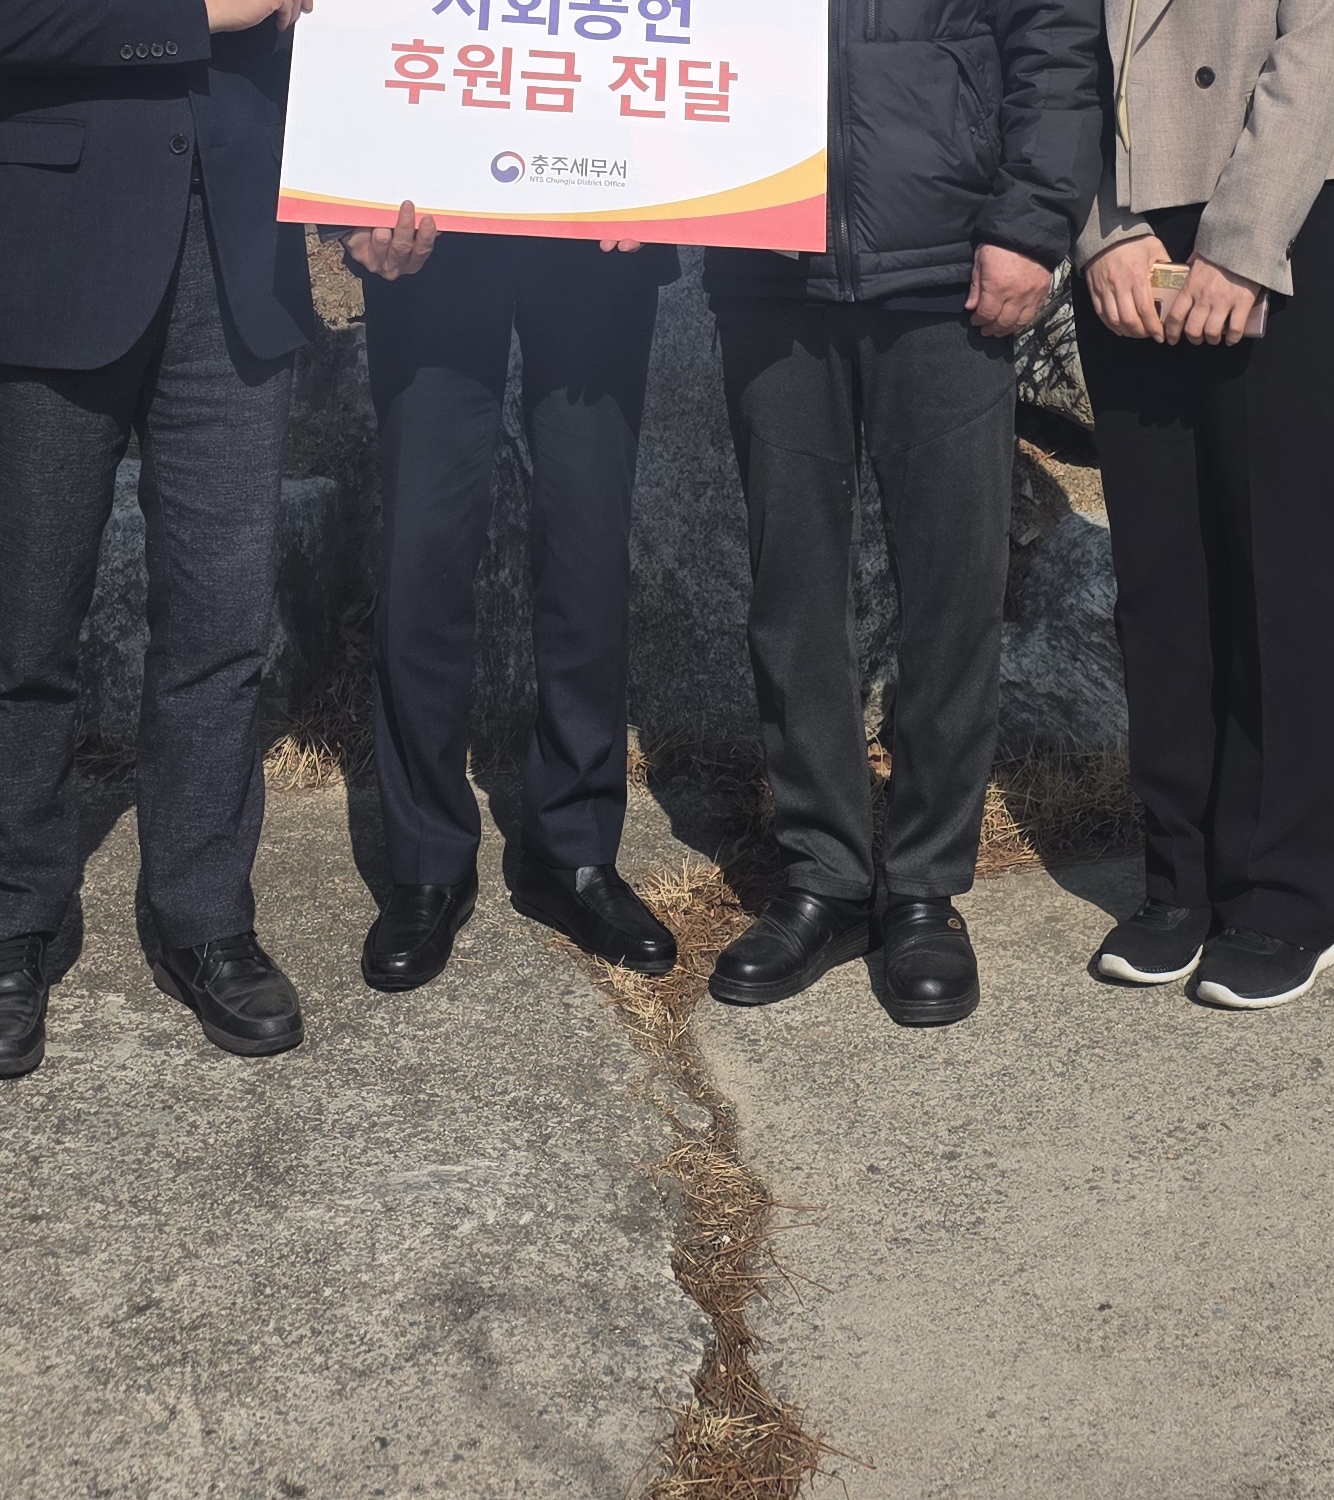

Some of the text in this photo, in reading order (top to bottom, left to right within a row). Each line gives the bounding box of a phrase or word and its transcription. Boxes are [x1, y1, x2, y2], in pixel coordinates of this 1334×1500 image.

[384, 38, 739, 123] 후원금 전달
[531, 155, 627, 179] 충주세무서
[577, 179, 602, 187] District
[603, 180, 626, 188] Office
